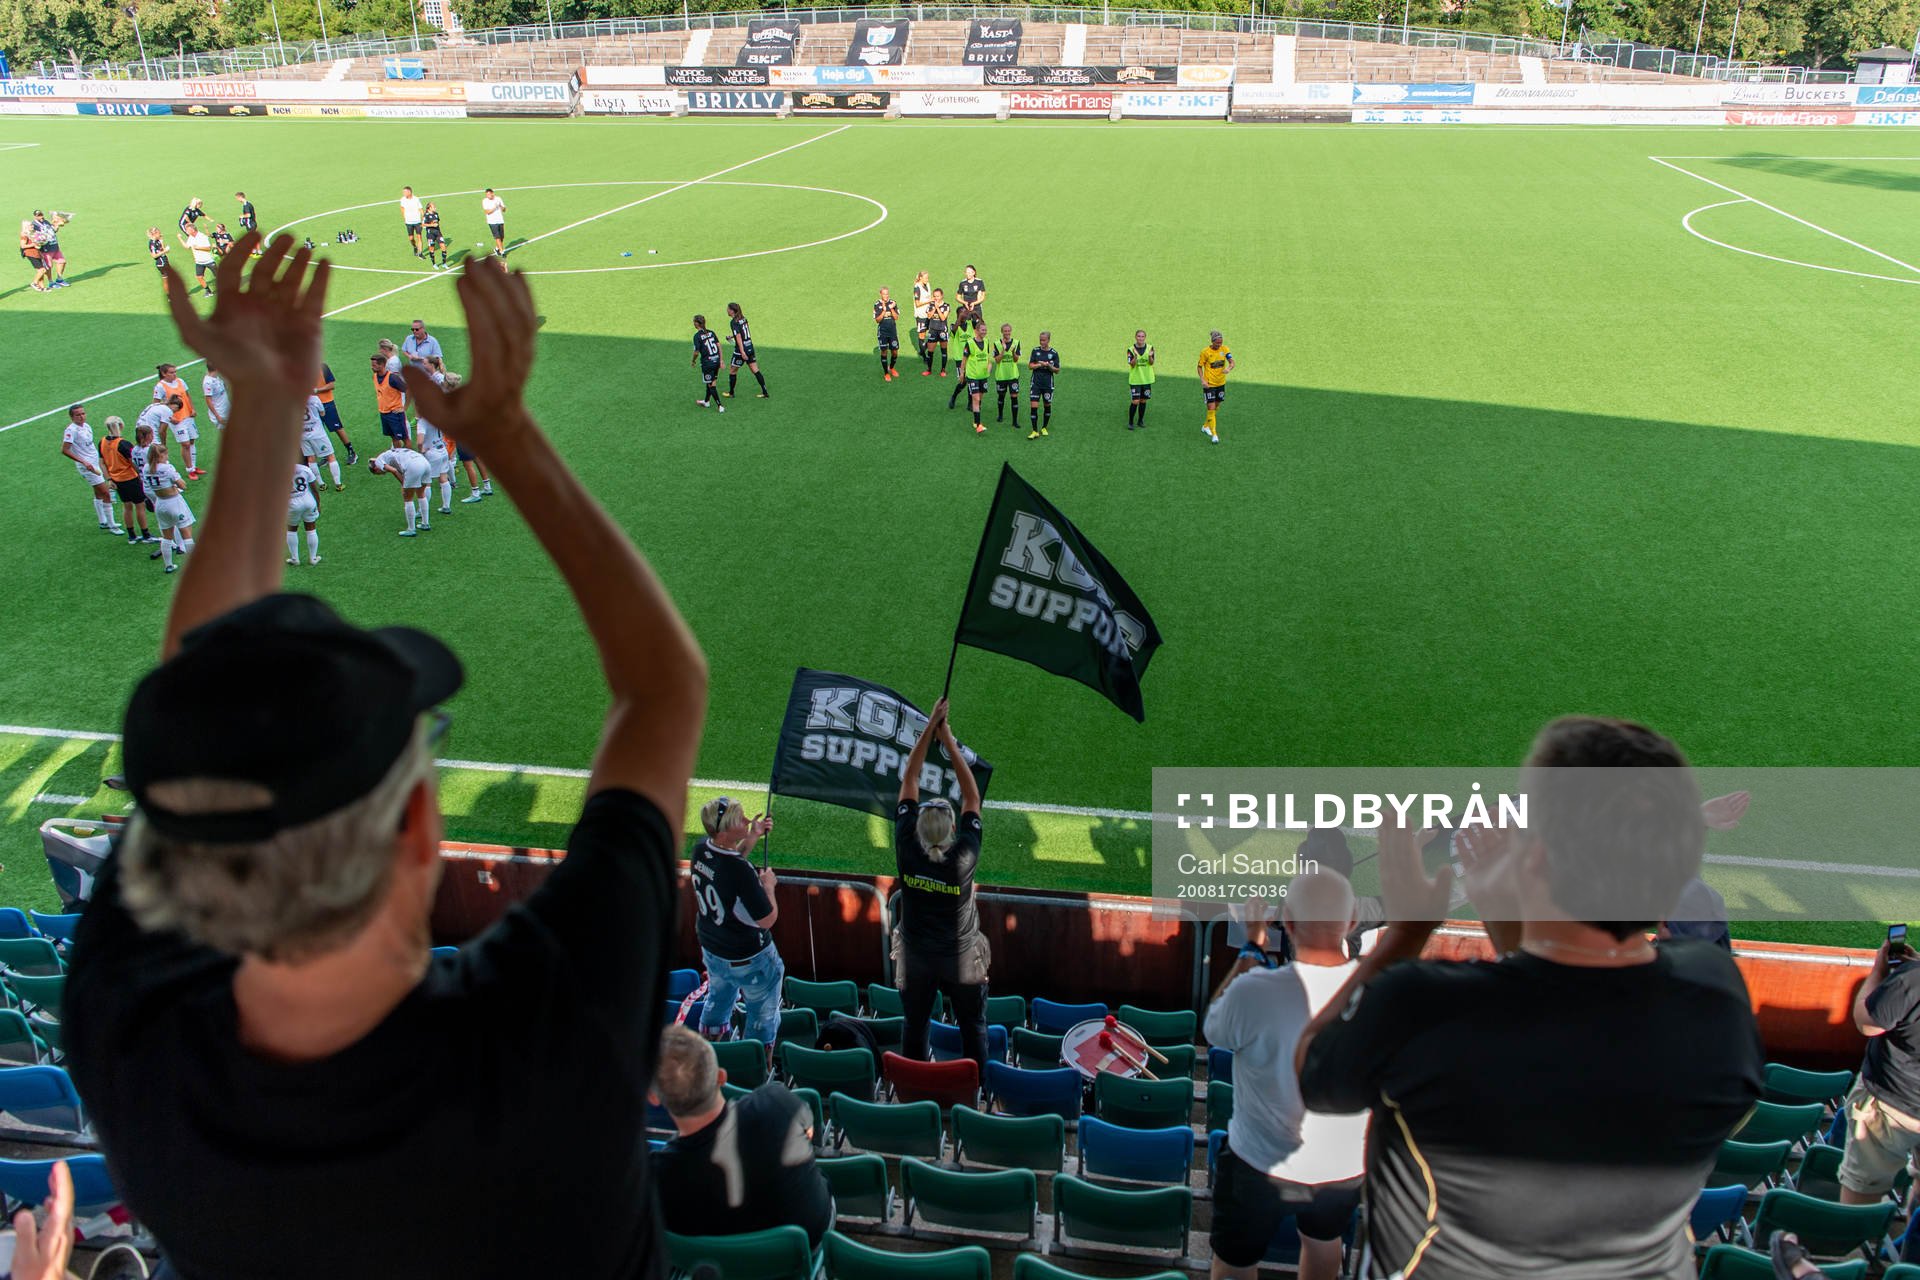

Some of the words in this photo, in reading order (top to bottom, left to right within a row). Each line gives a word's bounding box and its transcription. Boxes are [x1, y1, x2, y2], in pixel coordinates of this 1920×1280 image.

[968, 53, 1014, 63] BRIXLY
[727, 69, 758, 77] NORDIC
[988, 75, 1034, 83] WELLNESS
[1043, 75, 1090, 83] WELLNESS
[1, 81, 55, 96] Tvättex
[183, 82, 257, 97] BAUHAUS
[491, 85, 565, 100] GRUPPEN
[1784, 86, 1846, 100] BUCKETS
[695, 92, 776, 109] BRIXLY
[1011, 93, 1067, 109] Prioritet
[1068, 94, 1112, 109] Finans
[96, 103, 150, 116] BRIXLY
[704, 337, 718, 355] 15
[691, 873, 726, 927] 69
